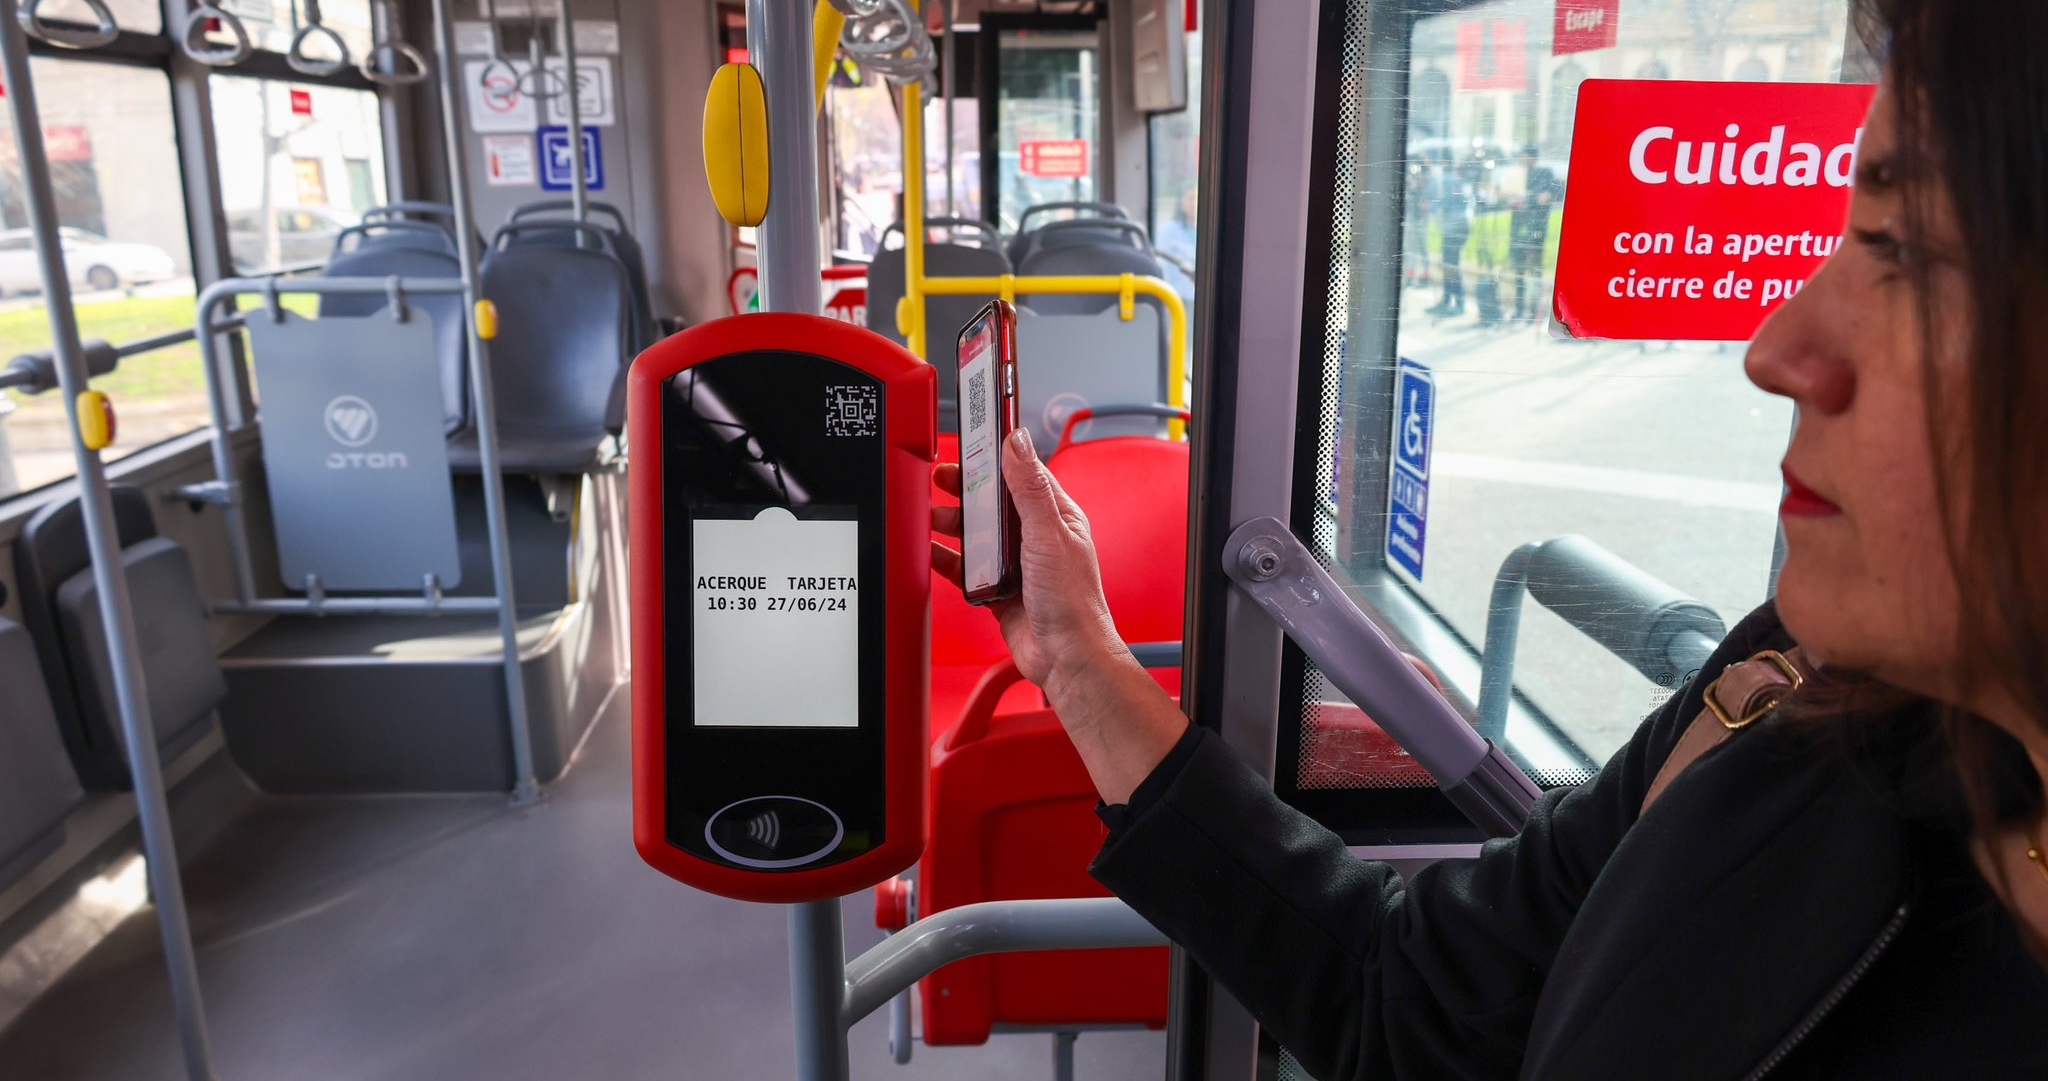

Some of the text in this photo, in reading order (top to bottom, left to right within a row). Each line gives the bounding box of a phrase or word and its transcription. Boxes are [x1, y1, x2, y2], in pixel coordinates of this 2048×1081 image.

[1629, 123, 1864, 187] Cuidad
[1614, 231, 1674, 255] con
[1685, 225, 1713, 255] la
[1607, 268, 1704, 299] cierre
[1713, 270, 1753, 299] de
[697, 576, 857, 591] ACERQUE TARJETA
[708, 597, 847, 612] 10:30 27/06/24
